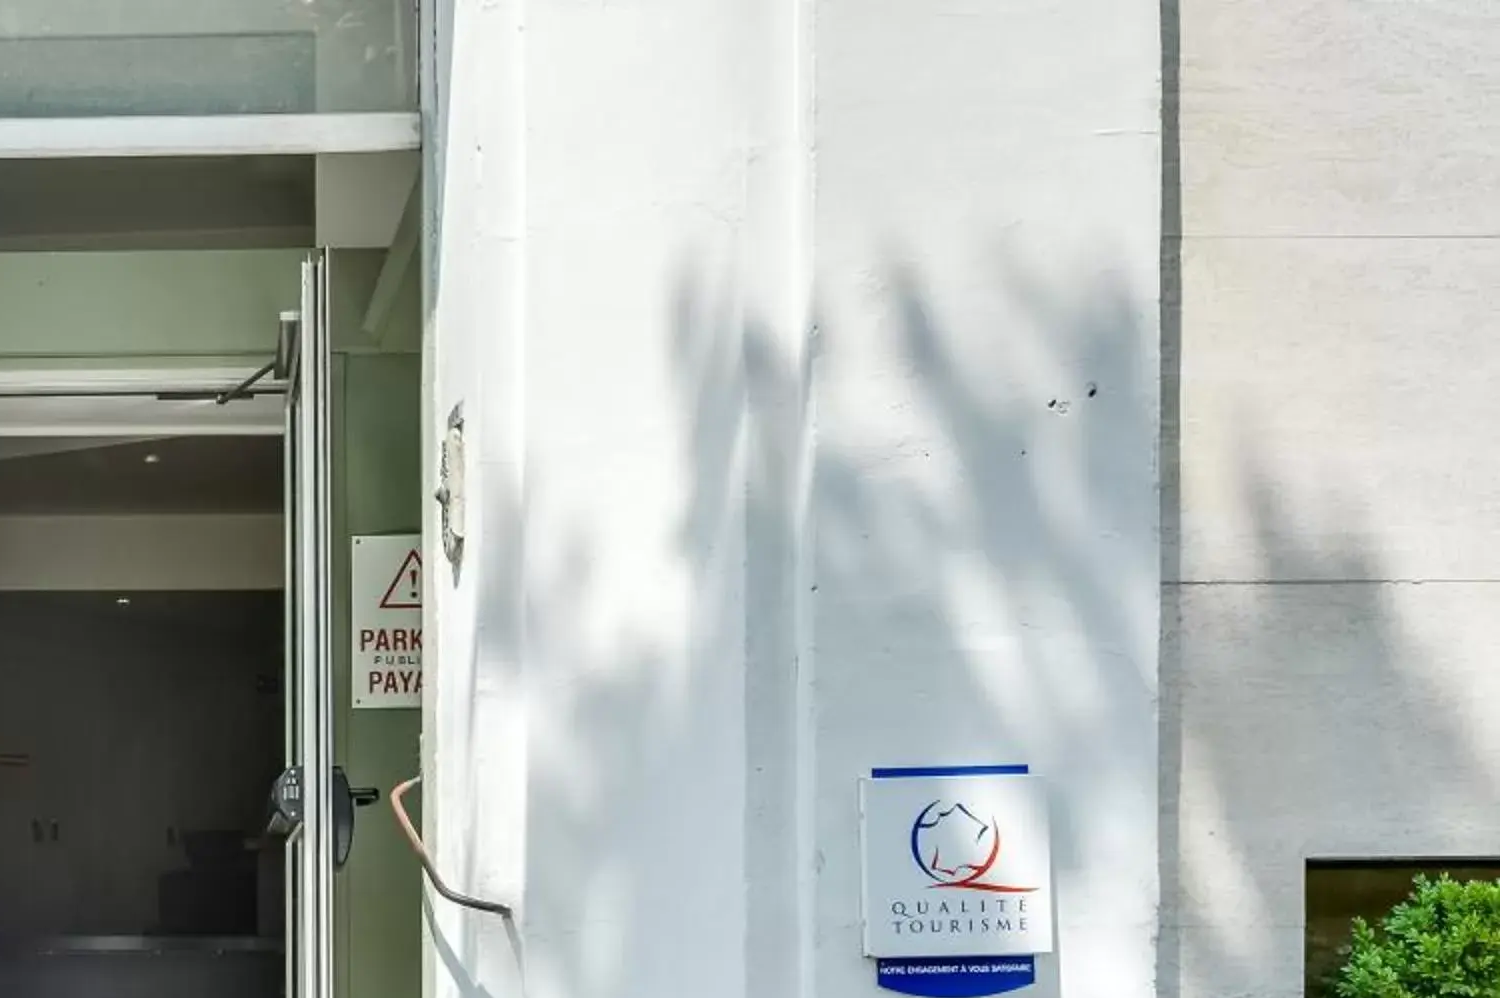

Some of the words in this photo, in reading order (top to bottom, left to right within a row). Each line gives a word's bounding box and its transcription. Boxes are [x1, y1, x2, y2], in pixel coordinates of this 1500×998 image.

[891, 896, 1028, 918] QUALITÉ
[892, 918, 1028, 934] TOURISME
[907, 965, 958, 974] ENGAGEMENT
[969, 965, 990, 973] VOUS
